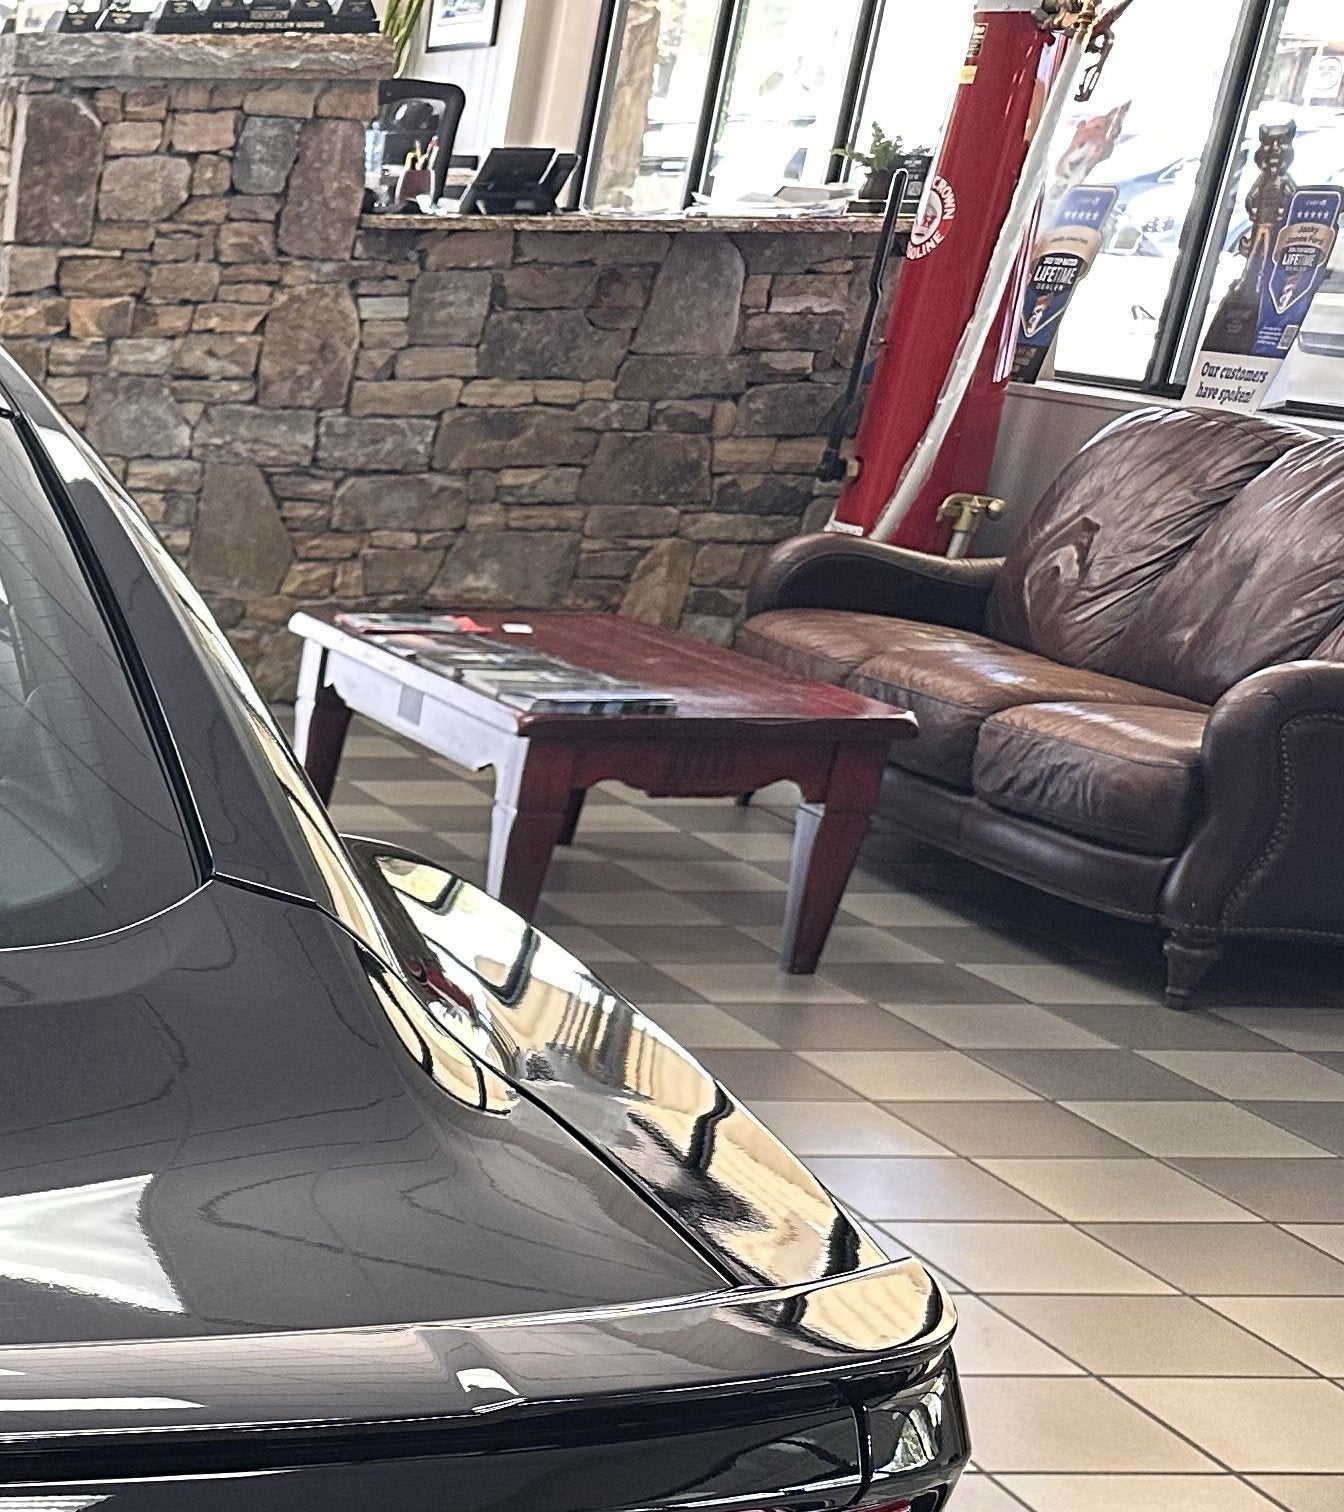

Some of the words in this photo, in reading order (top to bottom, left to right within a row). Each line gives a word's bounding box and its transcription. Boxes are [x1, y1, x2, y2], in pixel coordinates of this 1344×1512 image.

[932, 175, 956, 220] CROWN
[1033, 265, 1078, 285] LIFETIME
[1201, 361, 1220, 378] Our
[1220, 364, 1269, 384] customers
[1195, 381, 1218, 400] have
